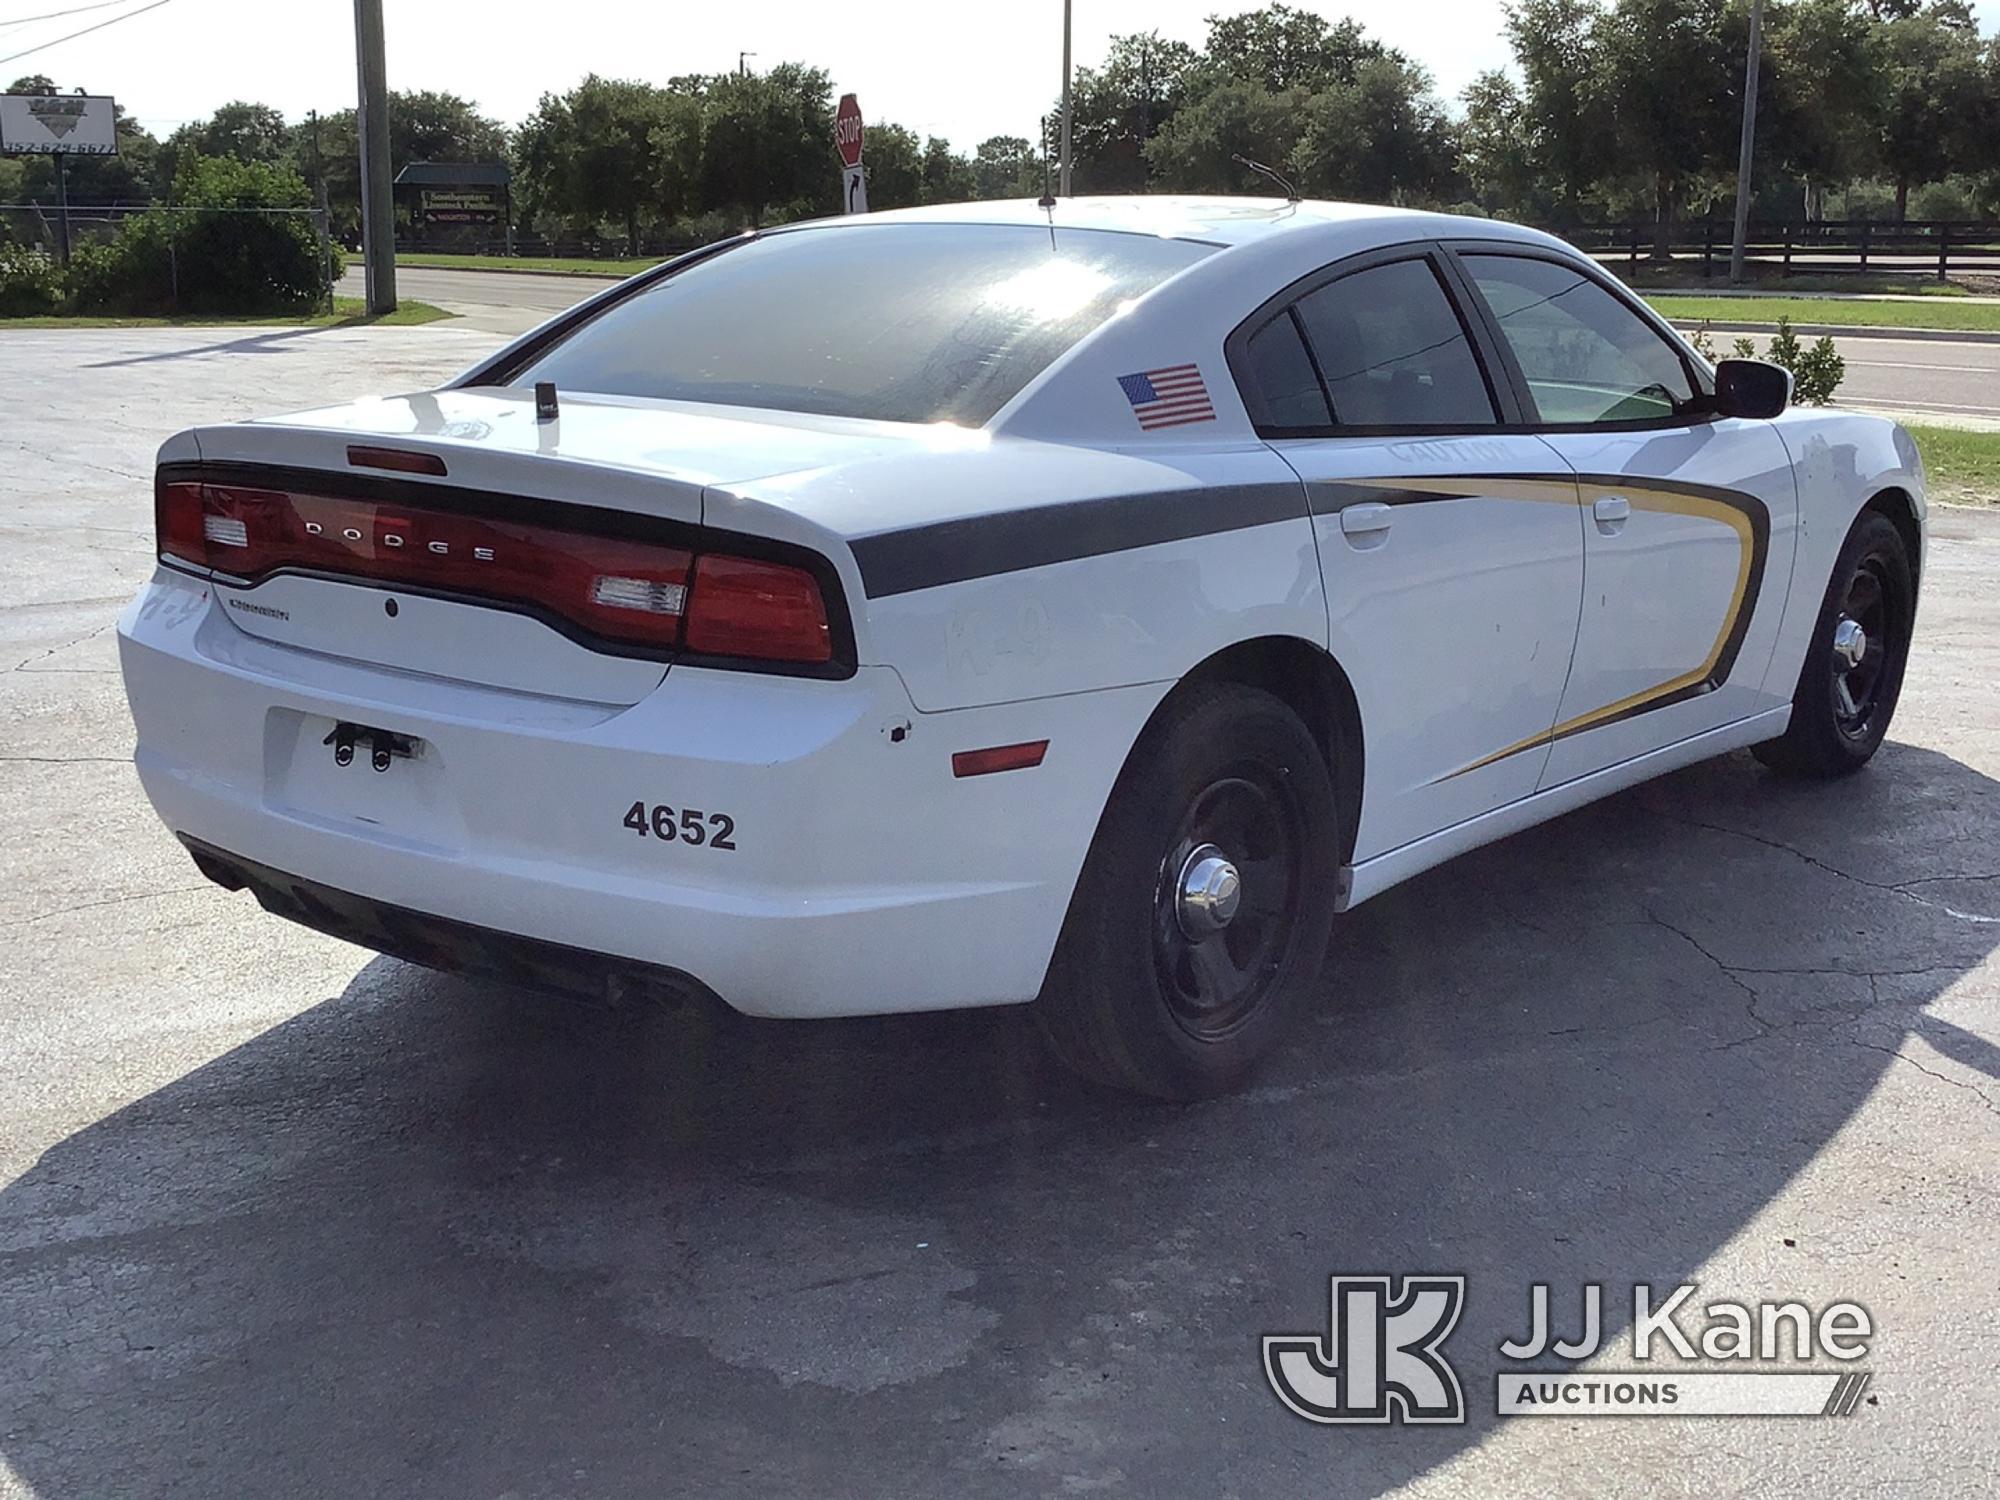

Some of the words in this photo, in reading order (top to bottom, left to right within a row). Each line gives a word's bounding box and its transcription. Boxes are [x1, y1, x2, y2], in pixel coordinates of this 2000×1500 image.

[839, 115, 860, 144] STOP
[306, 522, 494, 561] DODGE
[623, 801, 736, 851] 4652
